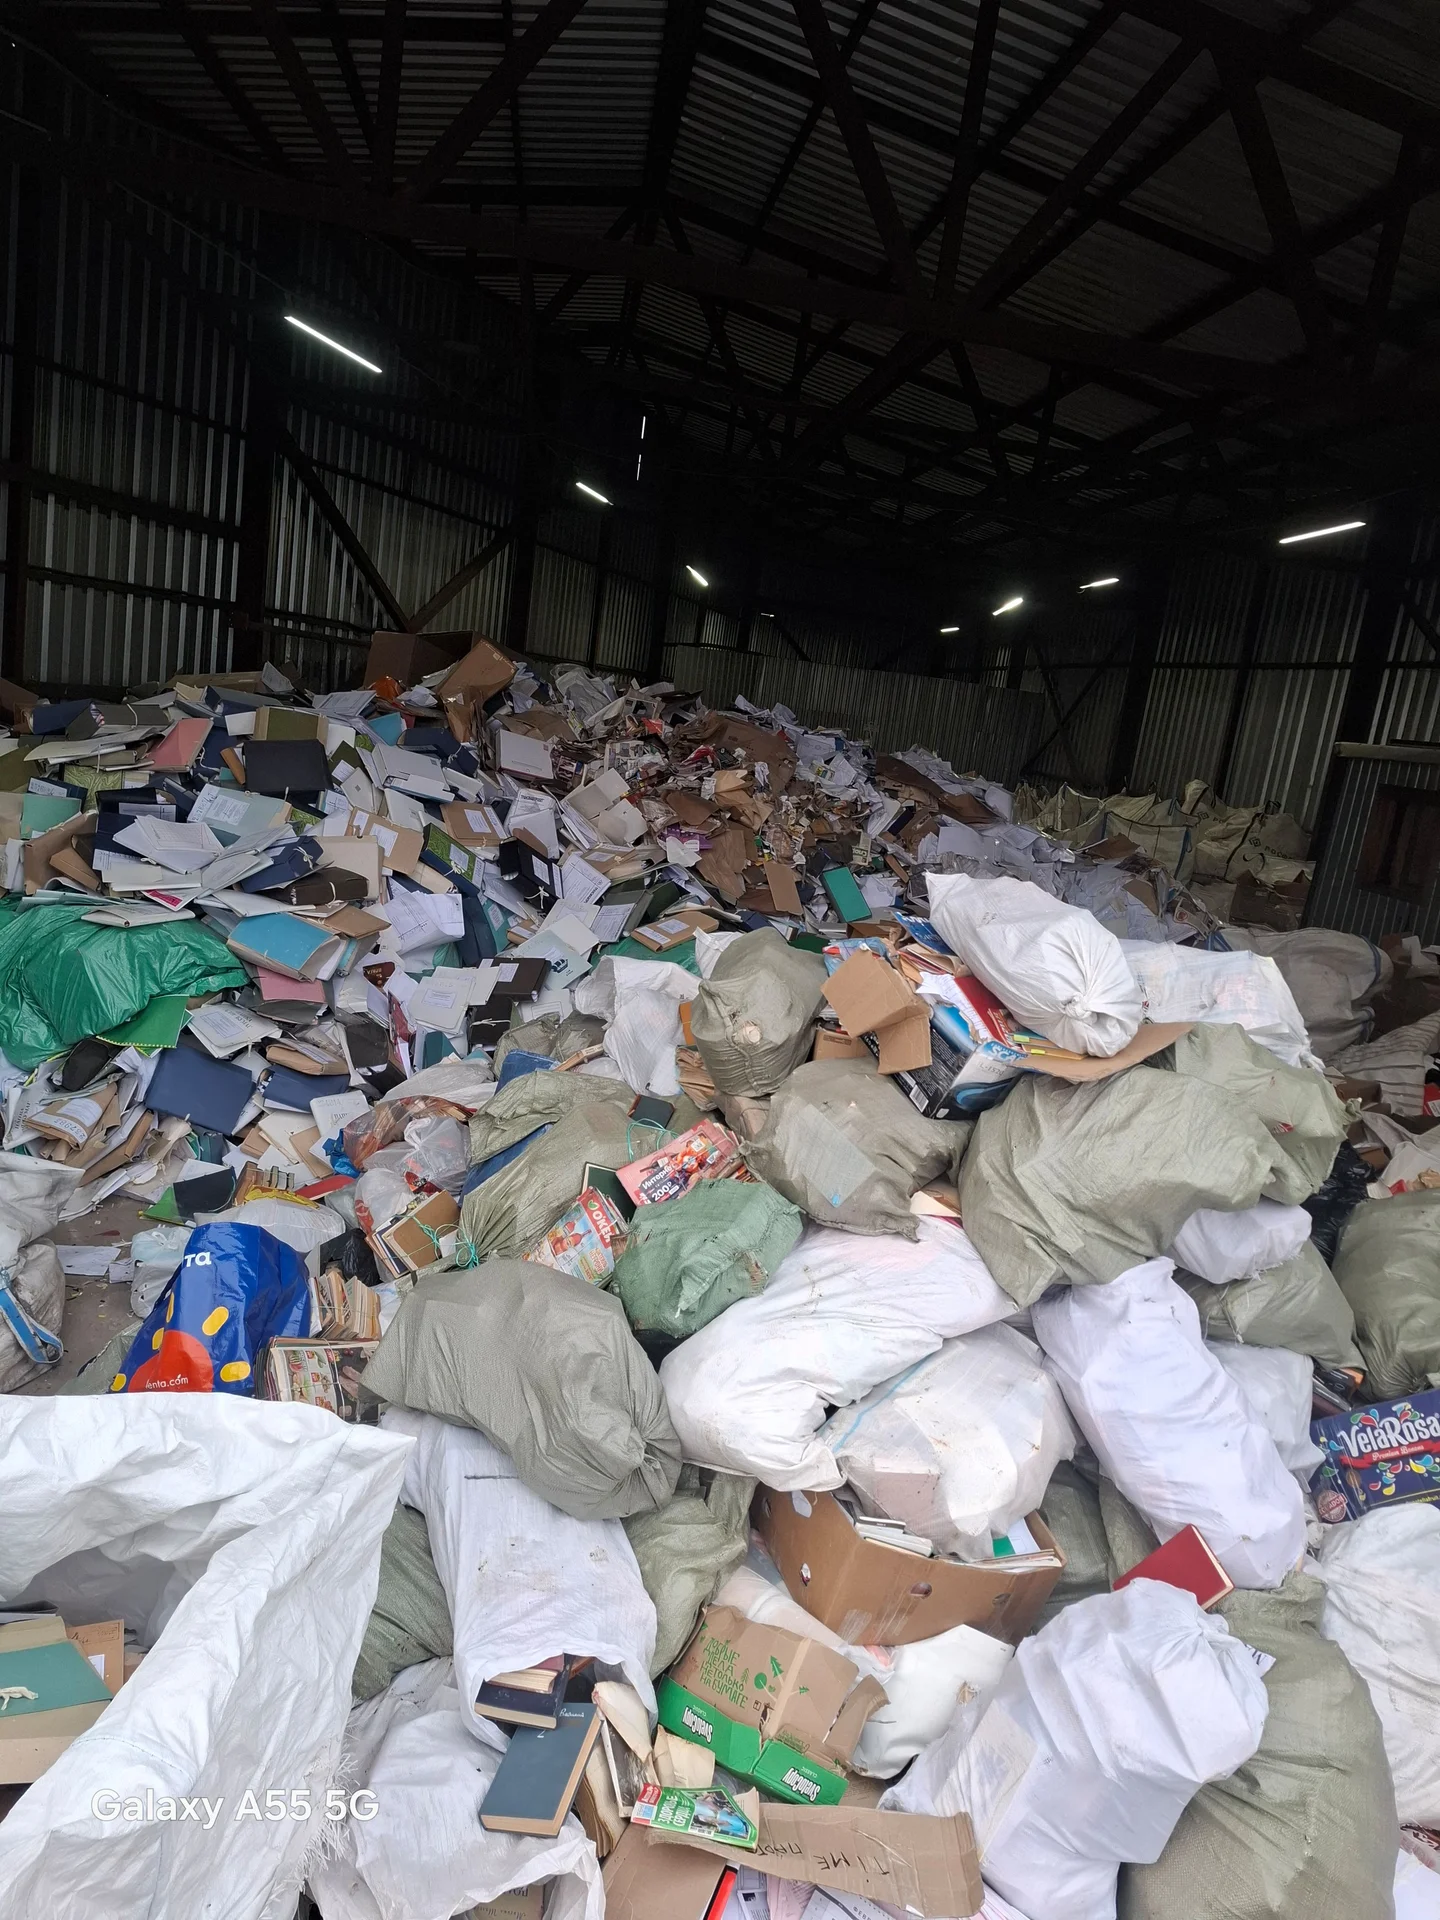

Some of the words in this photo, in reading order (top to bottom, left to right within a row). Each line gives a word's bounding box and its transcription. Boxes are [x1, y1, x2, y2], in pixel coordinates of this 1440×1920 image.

[1336, 1415, 1440, 1458] VelaRosa
[681, 1705, 714, 1744] SvetoCopy
[781, 1767, 821, 1802] SvetoCopy
